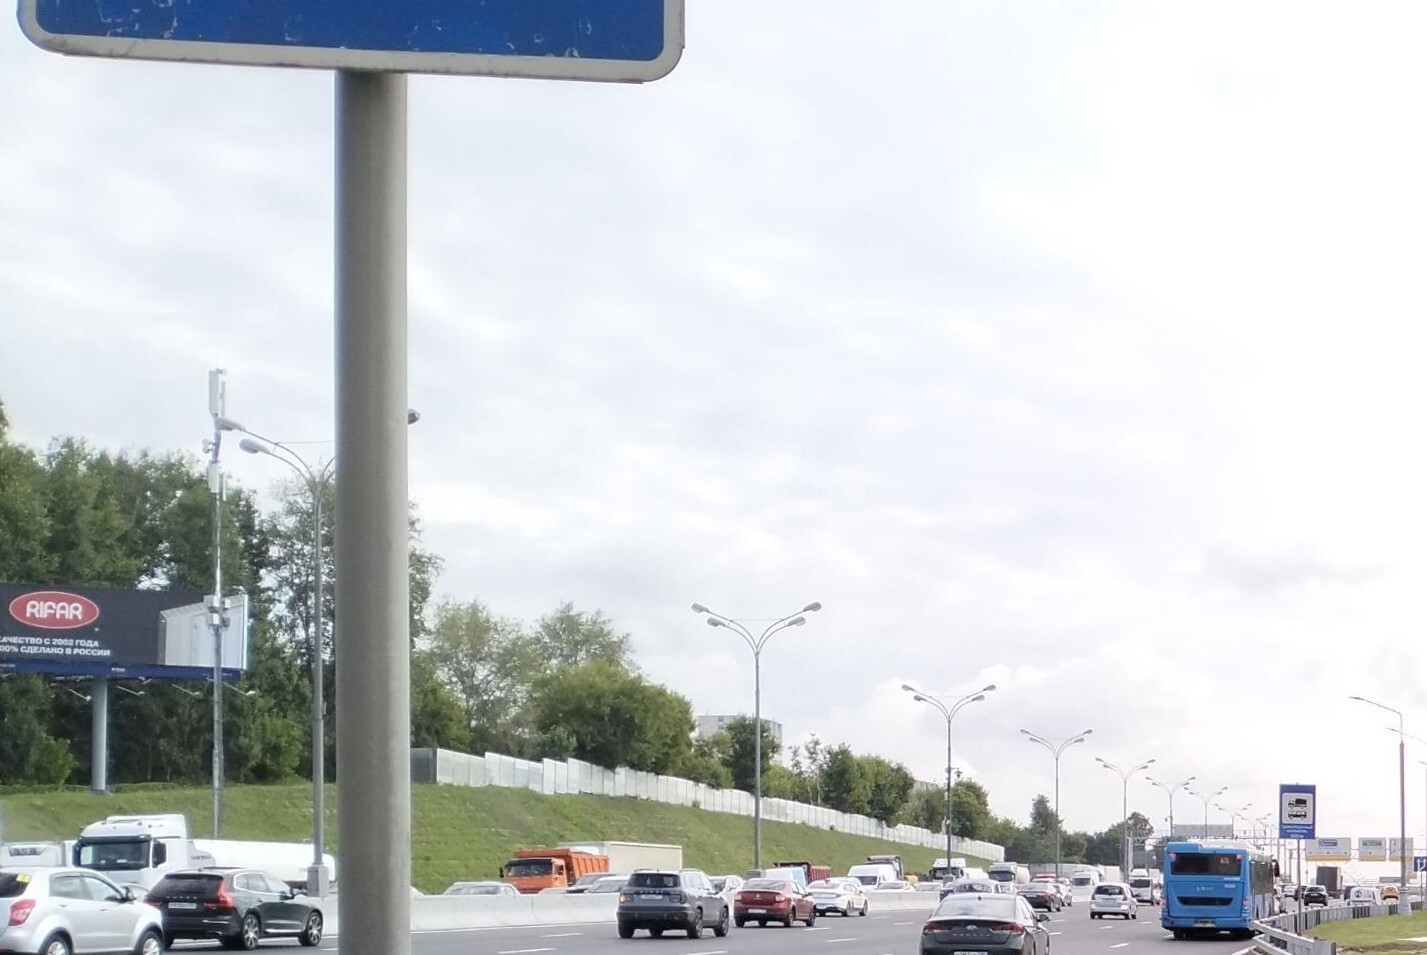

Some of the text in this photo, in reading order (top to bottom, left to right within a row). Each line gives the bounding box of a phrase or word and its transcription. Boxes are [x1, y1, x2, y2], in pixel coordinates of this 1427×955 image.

[26, 600, 82, 620] RIFAR
[44, 637, 50, 645] С
[75, 639, 99, 648] ГОДА
[0, 645, 18, 653] 00%
[20, 646, 63, 654] СДЕЛАНО
[73, 648, 110, 656] РОССИИ
